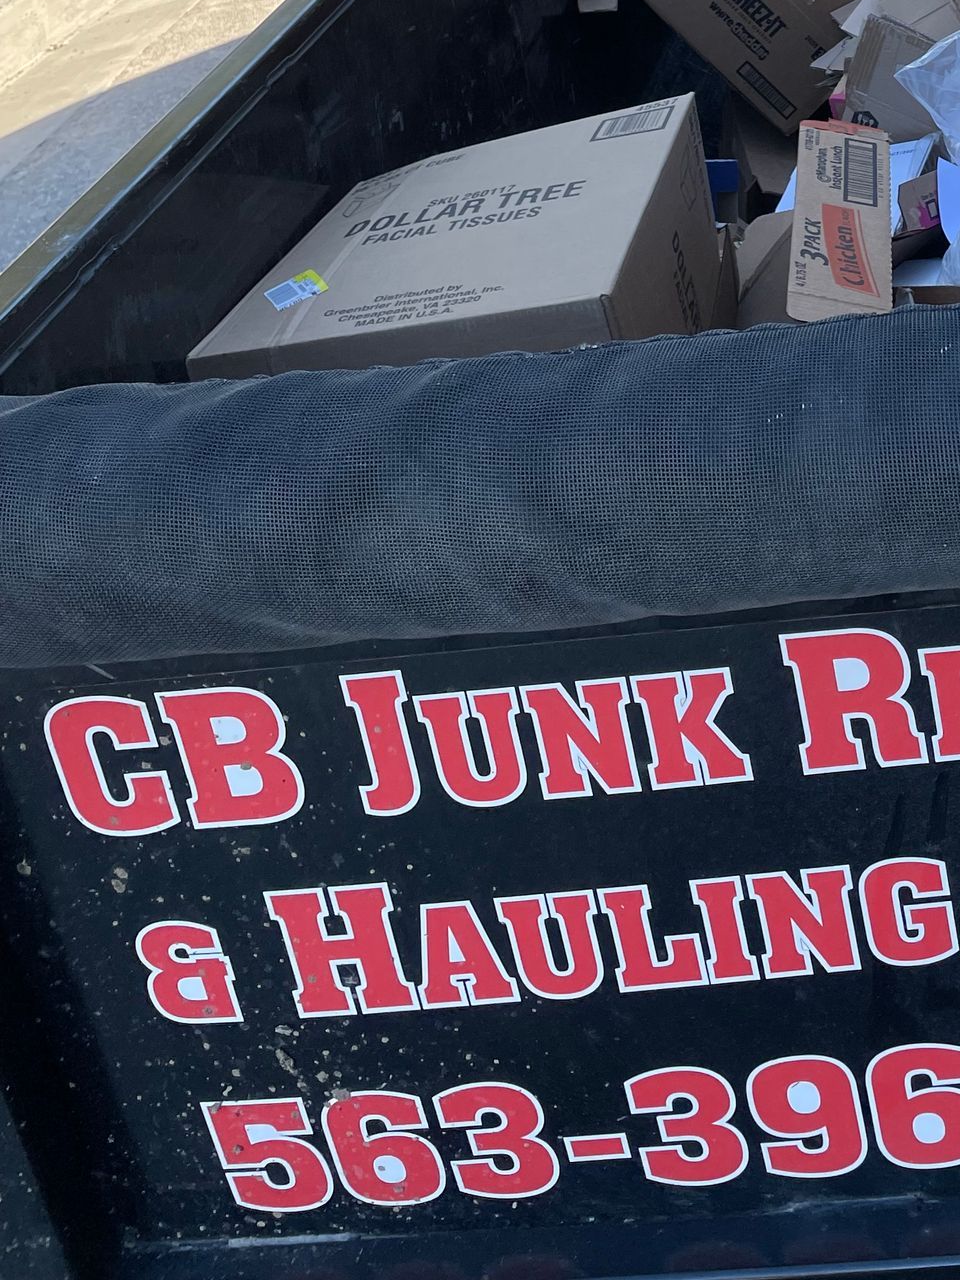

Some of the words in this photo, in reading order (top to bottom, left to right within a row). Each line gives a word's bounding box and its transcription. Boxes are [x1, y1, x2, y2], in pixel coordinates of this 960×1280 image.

[344, 197, 486, 238] DOLLAR
[498, 180, 587, 209] TREE
[427, 195, 460, 208] SKU
[464, 184, 516, 201] 260117
[361, 224, 437, 245] FACIAL
[448, 206, 542, 231] TISSUES
[834, 225, 865, 286] Chicken
[323, 300, 393, 317] Greenbrier
[395, 289, 478, 307] International,
[481, 285, 505, 294] Inc.
[337, 305, 418, 323] Chesapeake,
[423, 300, 440, 310] VA
[442, 295, 482, 307] 23320
[373, 286, 444, 303] Distributed
[446, 284, 464, 293] by
[354, 317, 394, 328] MADE
[397, 313, 412, 321] IN
[415, 308, 454, 319] U.S.A.
[43, 685, 306, 837] CB
[135, 919, 246, 1025] &
